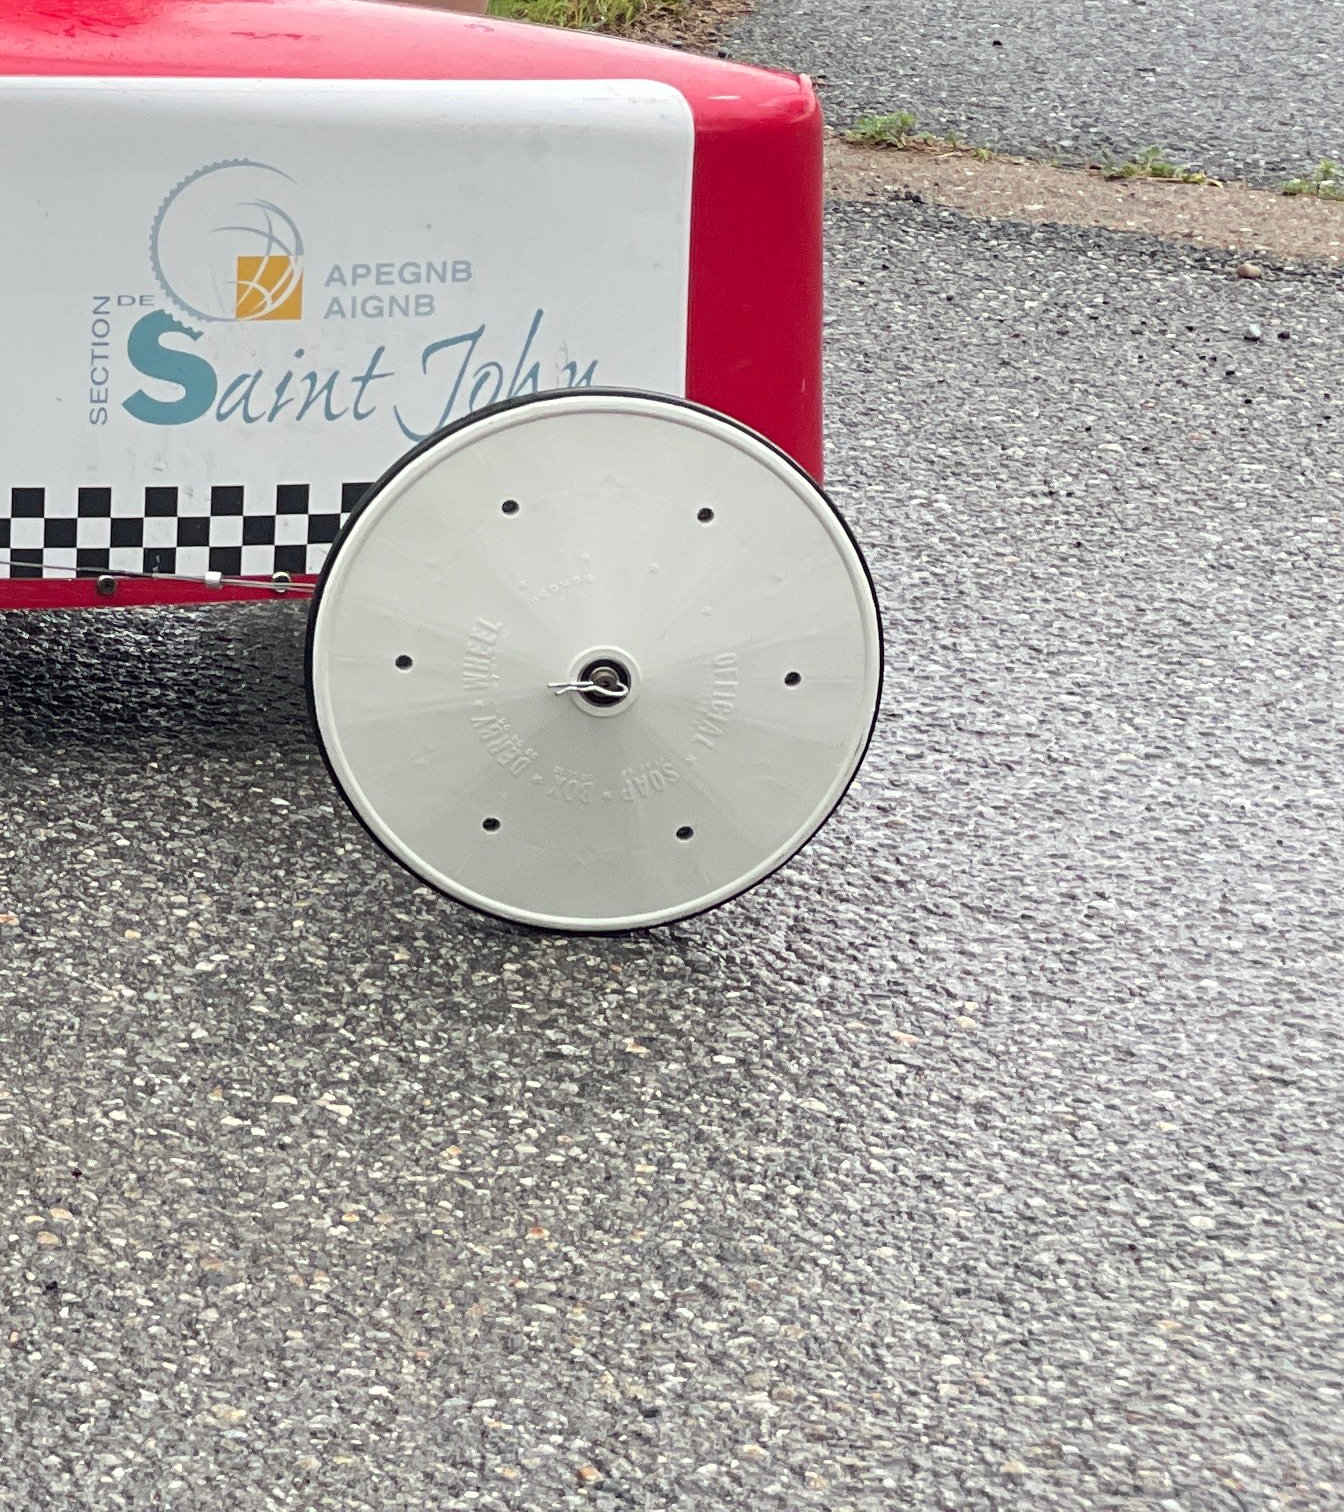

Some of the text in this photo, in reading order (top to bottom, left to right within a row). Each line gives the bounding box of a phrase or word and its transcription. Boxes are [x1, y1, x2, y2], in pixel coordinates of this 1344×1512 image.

[324, 259, 473, 288] APEGNB
[324, 294, 436, 320] AIGNB
[89, 294, 155, 426] SECTION DE
[122, 308, 600, 443] Saint John
